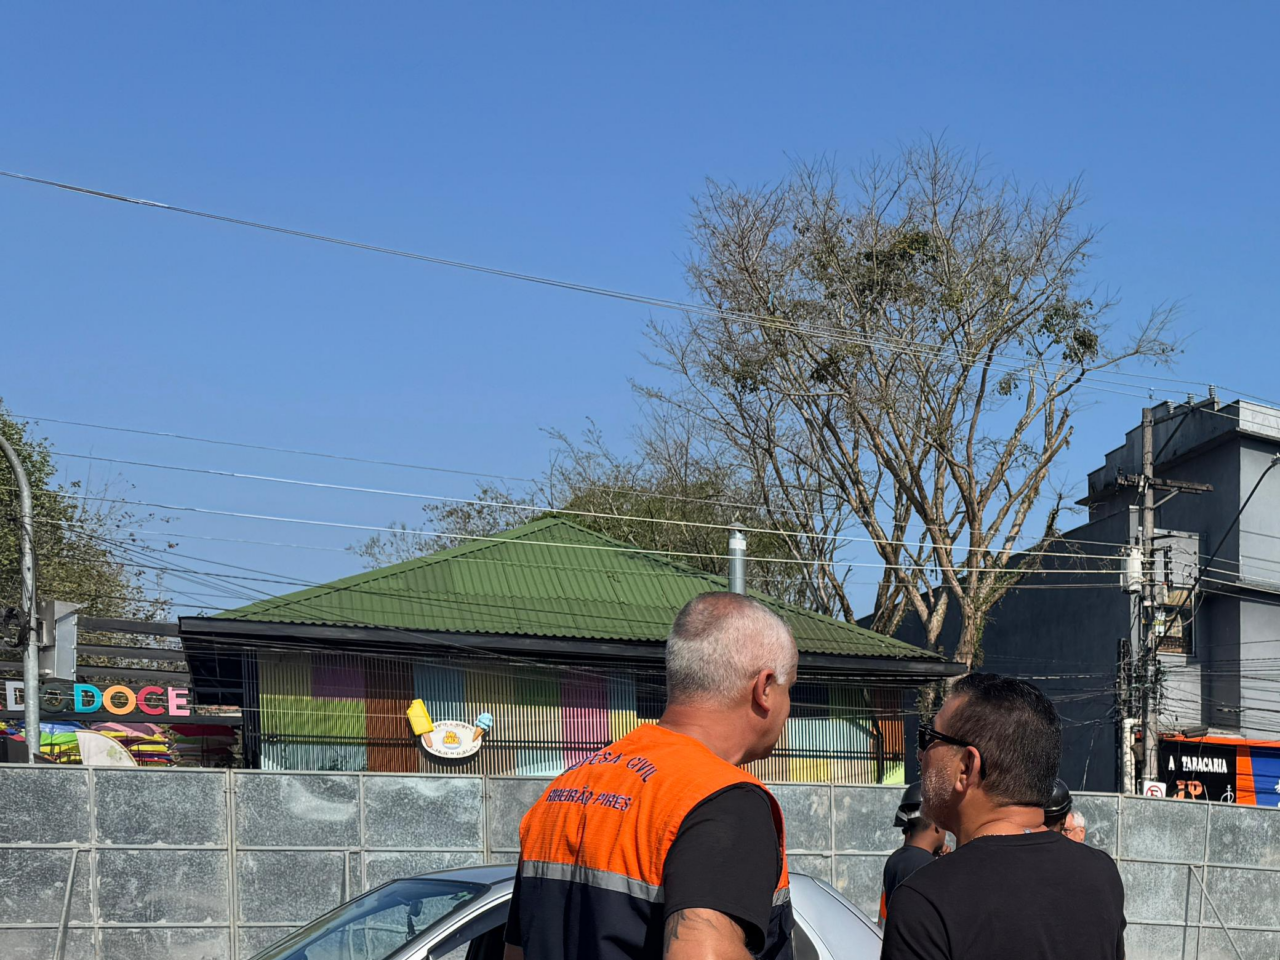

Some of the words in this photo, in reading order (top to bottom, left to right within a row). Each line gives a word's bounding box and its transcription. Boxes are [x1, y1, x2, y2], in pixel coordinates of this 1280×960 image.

[73, 683, 191, 717] DOCE
[626, 757, 658, 783] CIVIL
[1168, 755, 1175, 771] A
[546, 785, 594, 805] RIBEIRÃO
[593, 792, 632, 811] PIRES
